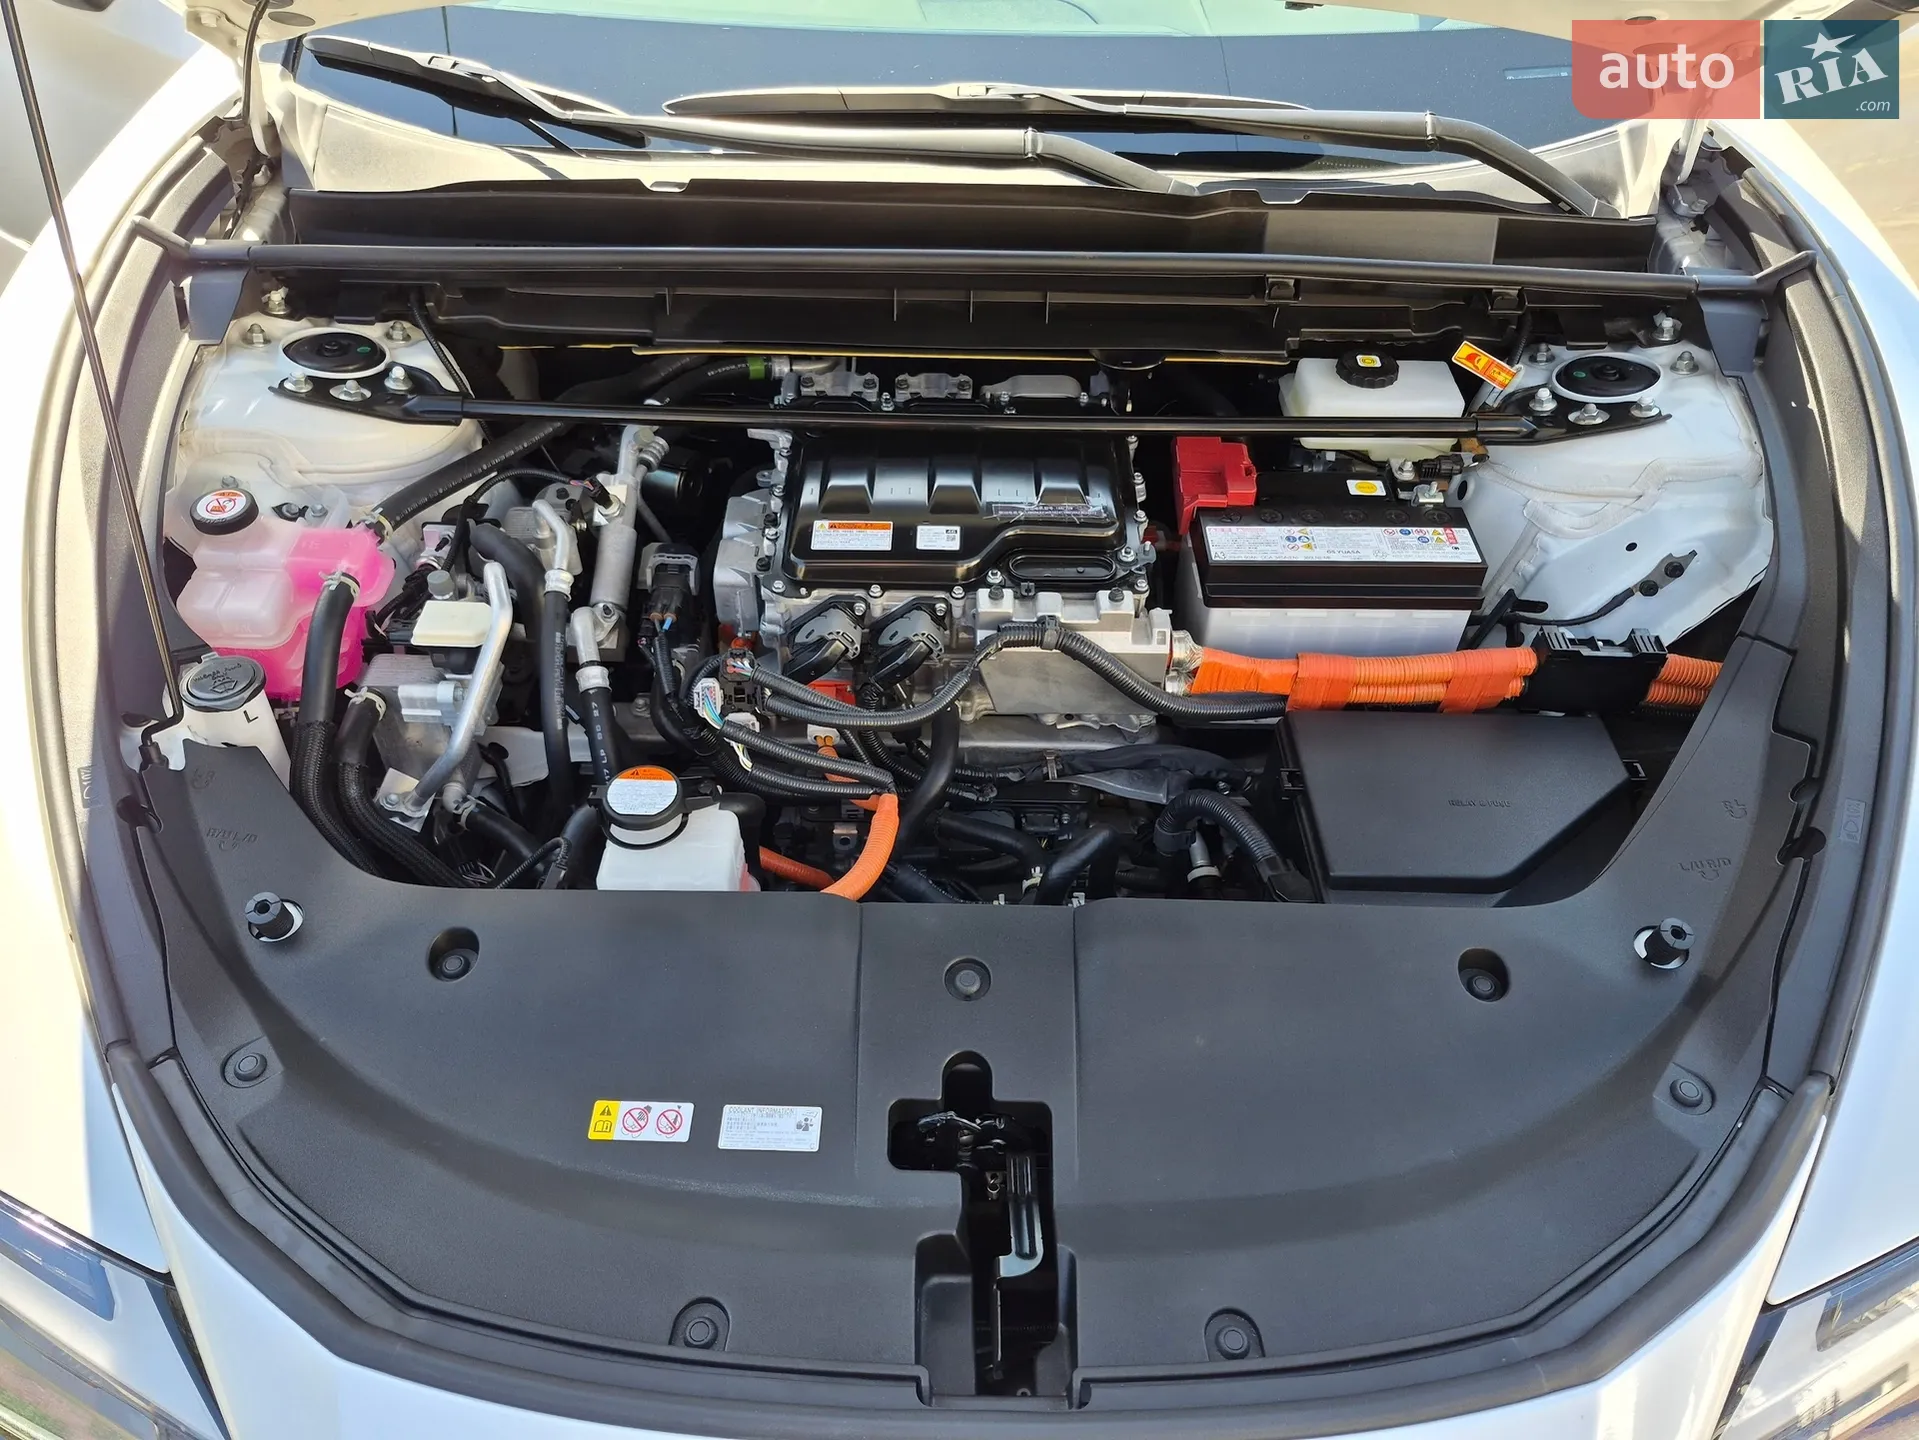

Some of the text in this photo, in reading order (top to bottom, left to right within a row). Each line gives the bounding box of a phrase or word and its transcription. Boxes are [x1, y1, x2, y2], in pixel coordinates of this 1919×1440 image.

[243, 710, 259, 724] L
[728, 1106, 755, 1114] COOLANT
[756, 1107, 795, 1115] INFORMATION
